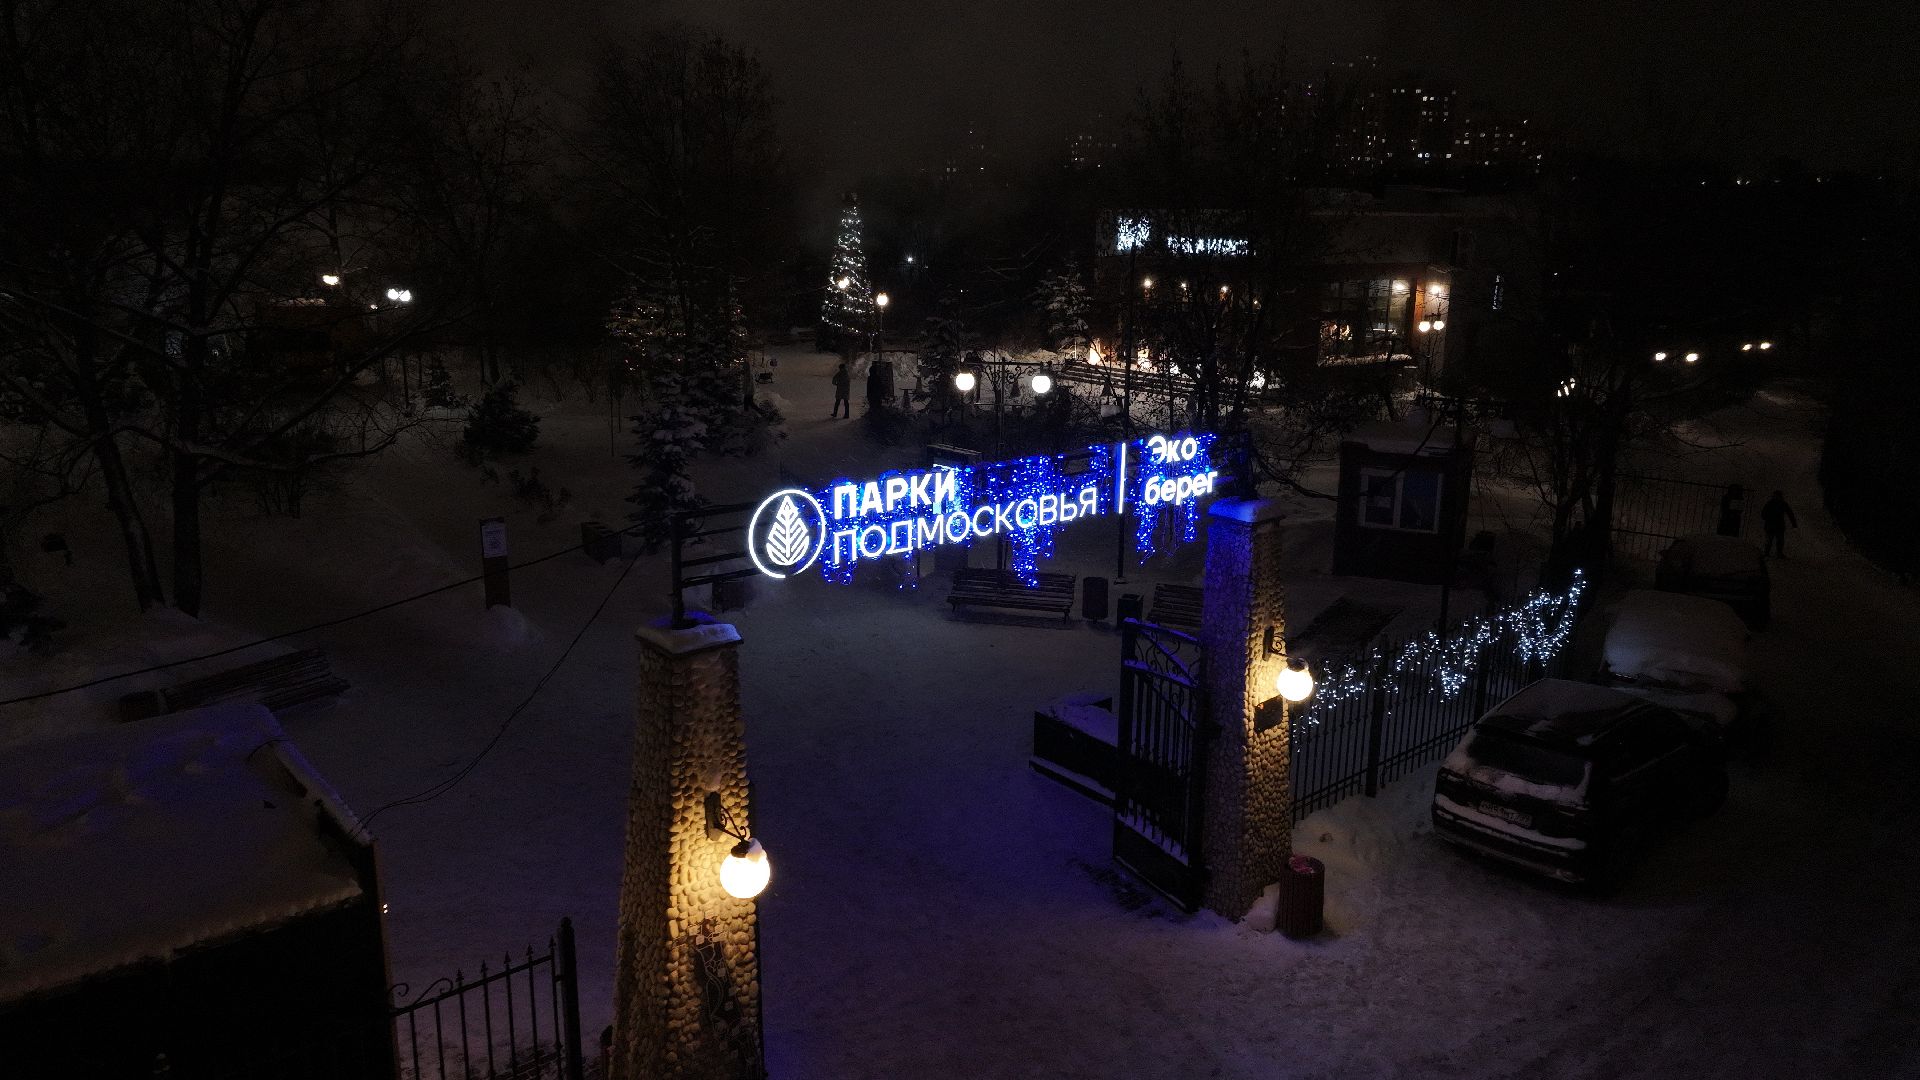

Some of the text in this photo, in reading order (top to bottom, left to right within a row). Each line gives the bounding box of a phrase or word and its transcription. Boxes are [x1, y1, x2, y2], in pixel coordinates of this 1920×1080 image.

[1147, 435, 1197, 464] Эко
[833, 470, 956, 519] ПАРКИ
[1145, 470, 1218, 506] берег
[832, 487, 1097, 564] ПОДМОСКОВЬЯ
